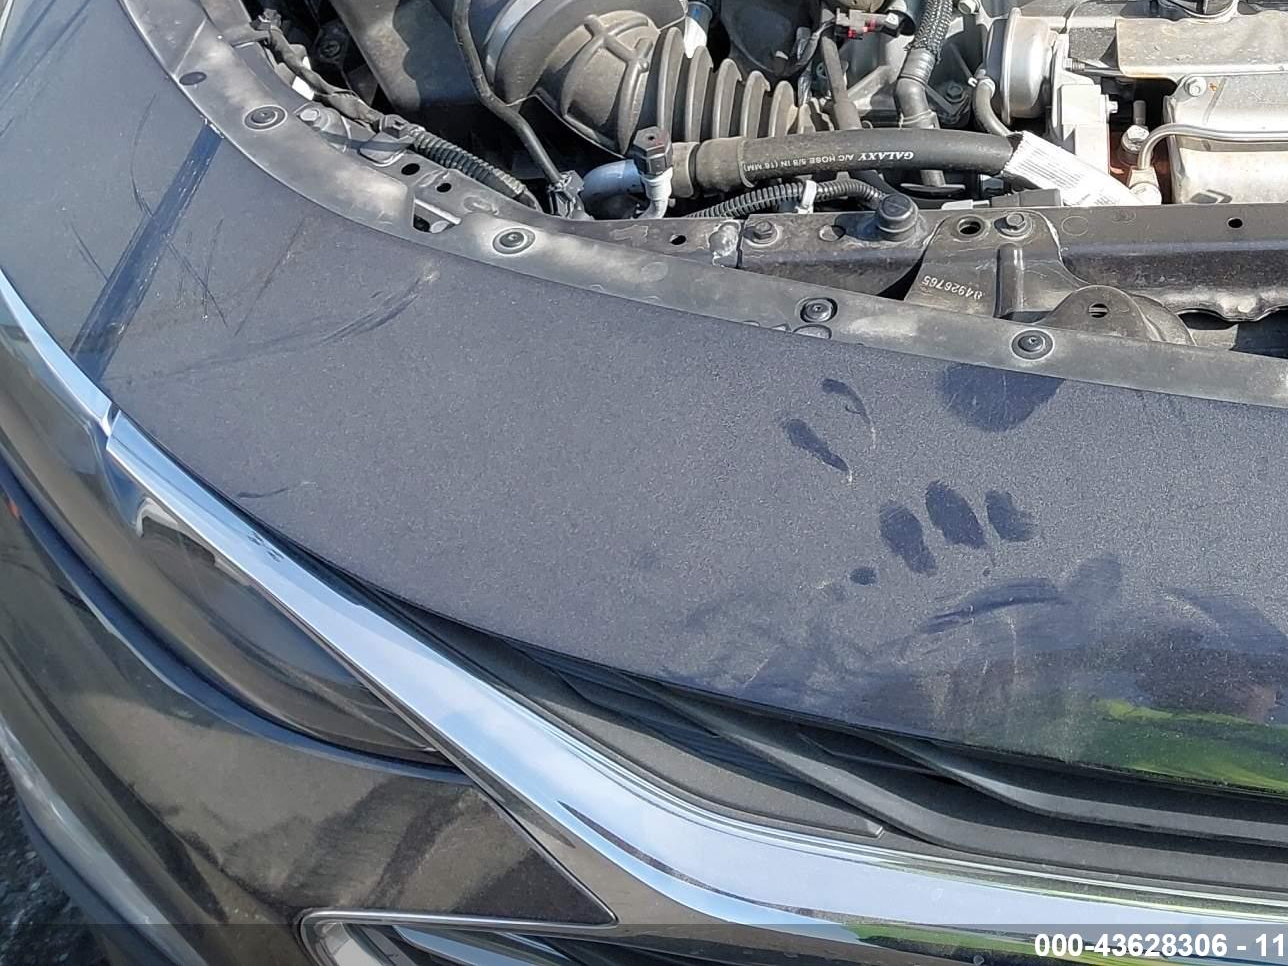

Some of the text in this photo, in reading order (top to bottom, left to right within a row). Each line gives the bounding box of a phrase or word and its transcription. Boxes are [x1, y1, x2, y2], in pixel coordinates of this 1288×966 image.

[809, 154, 836, 164] HOSE
[838, 153, 855, 162] A/C
[857, 151, 914, 162] GALAXY
[780, 159, 791, 167] IN
